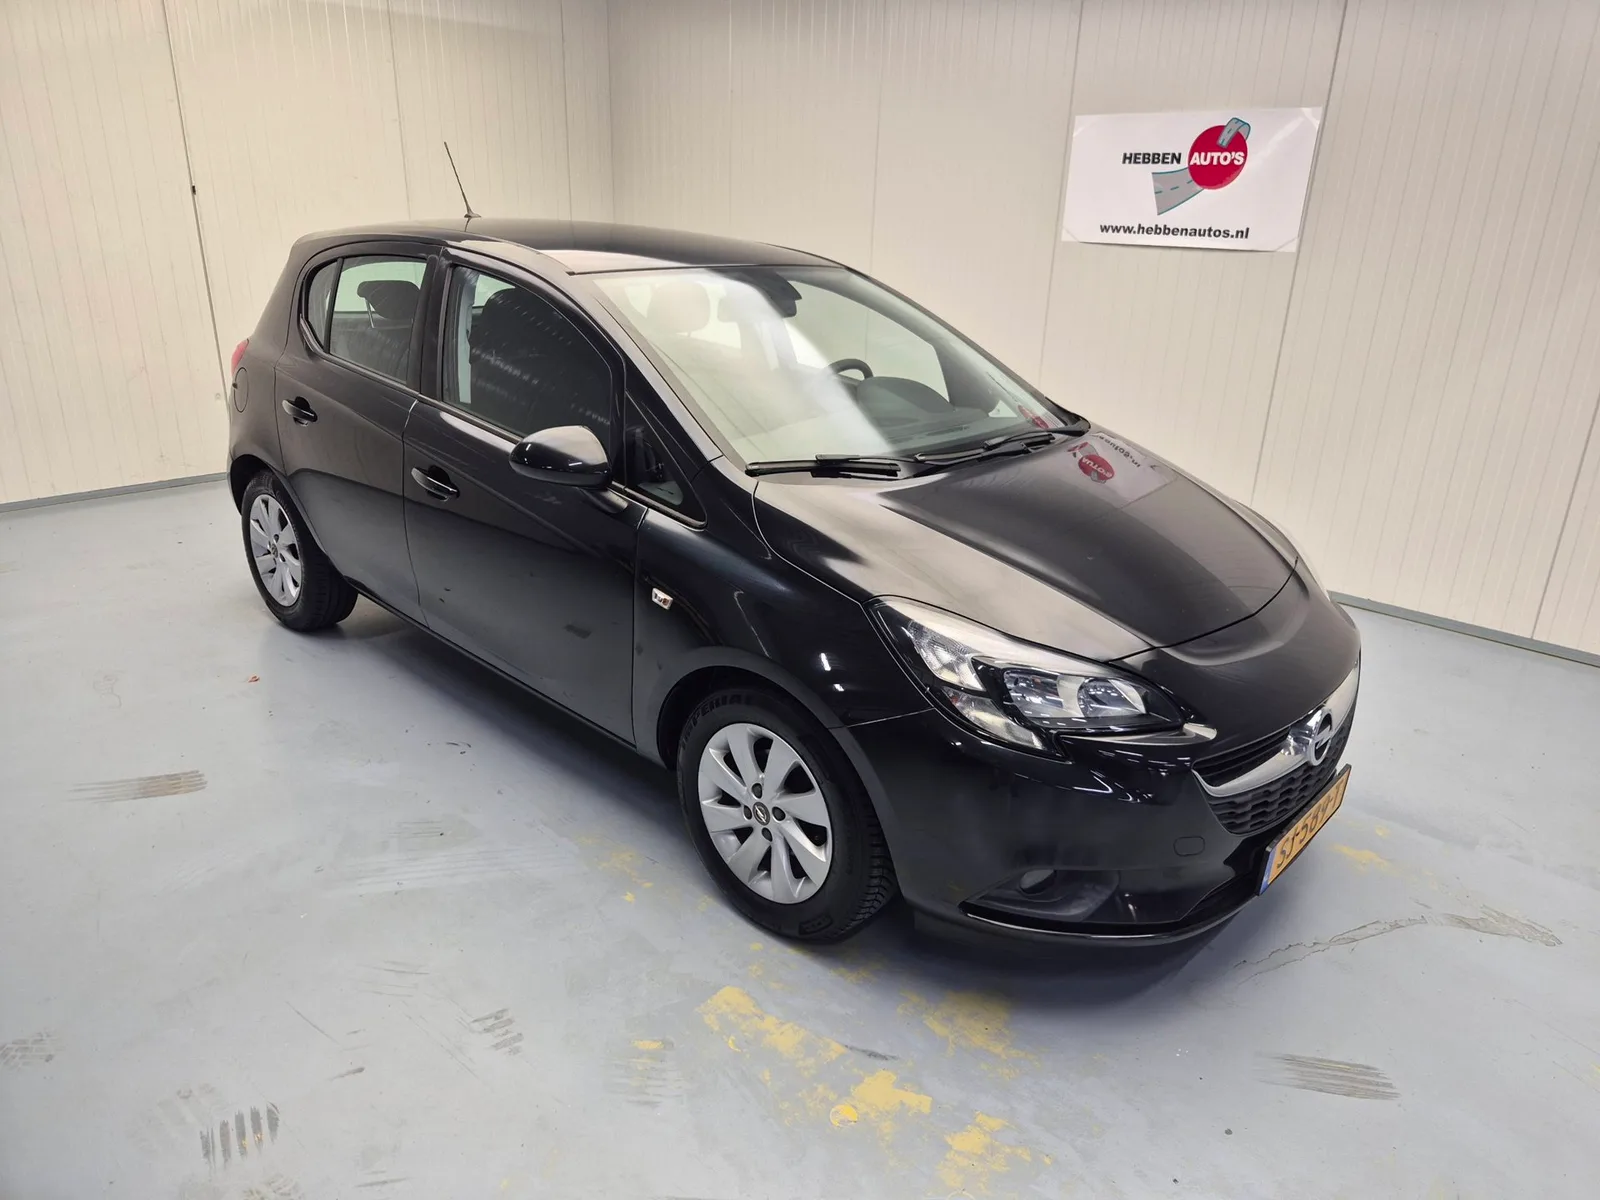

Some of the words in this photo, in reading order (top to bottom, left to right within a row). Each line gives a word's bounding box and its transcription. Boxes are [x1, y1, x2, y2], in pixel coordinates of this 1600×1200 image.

[1121, 152, 1182, 165] HEBBEN
[1189, 151, 1245, 166] AUTO'S
[1099, 223, 1250, 239] www.hebbenautos.nl
